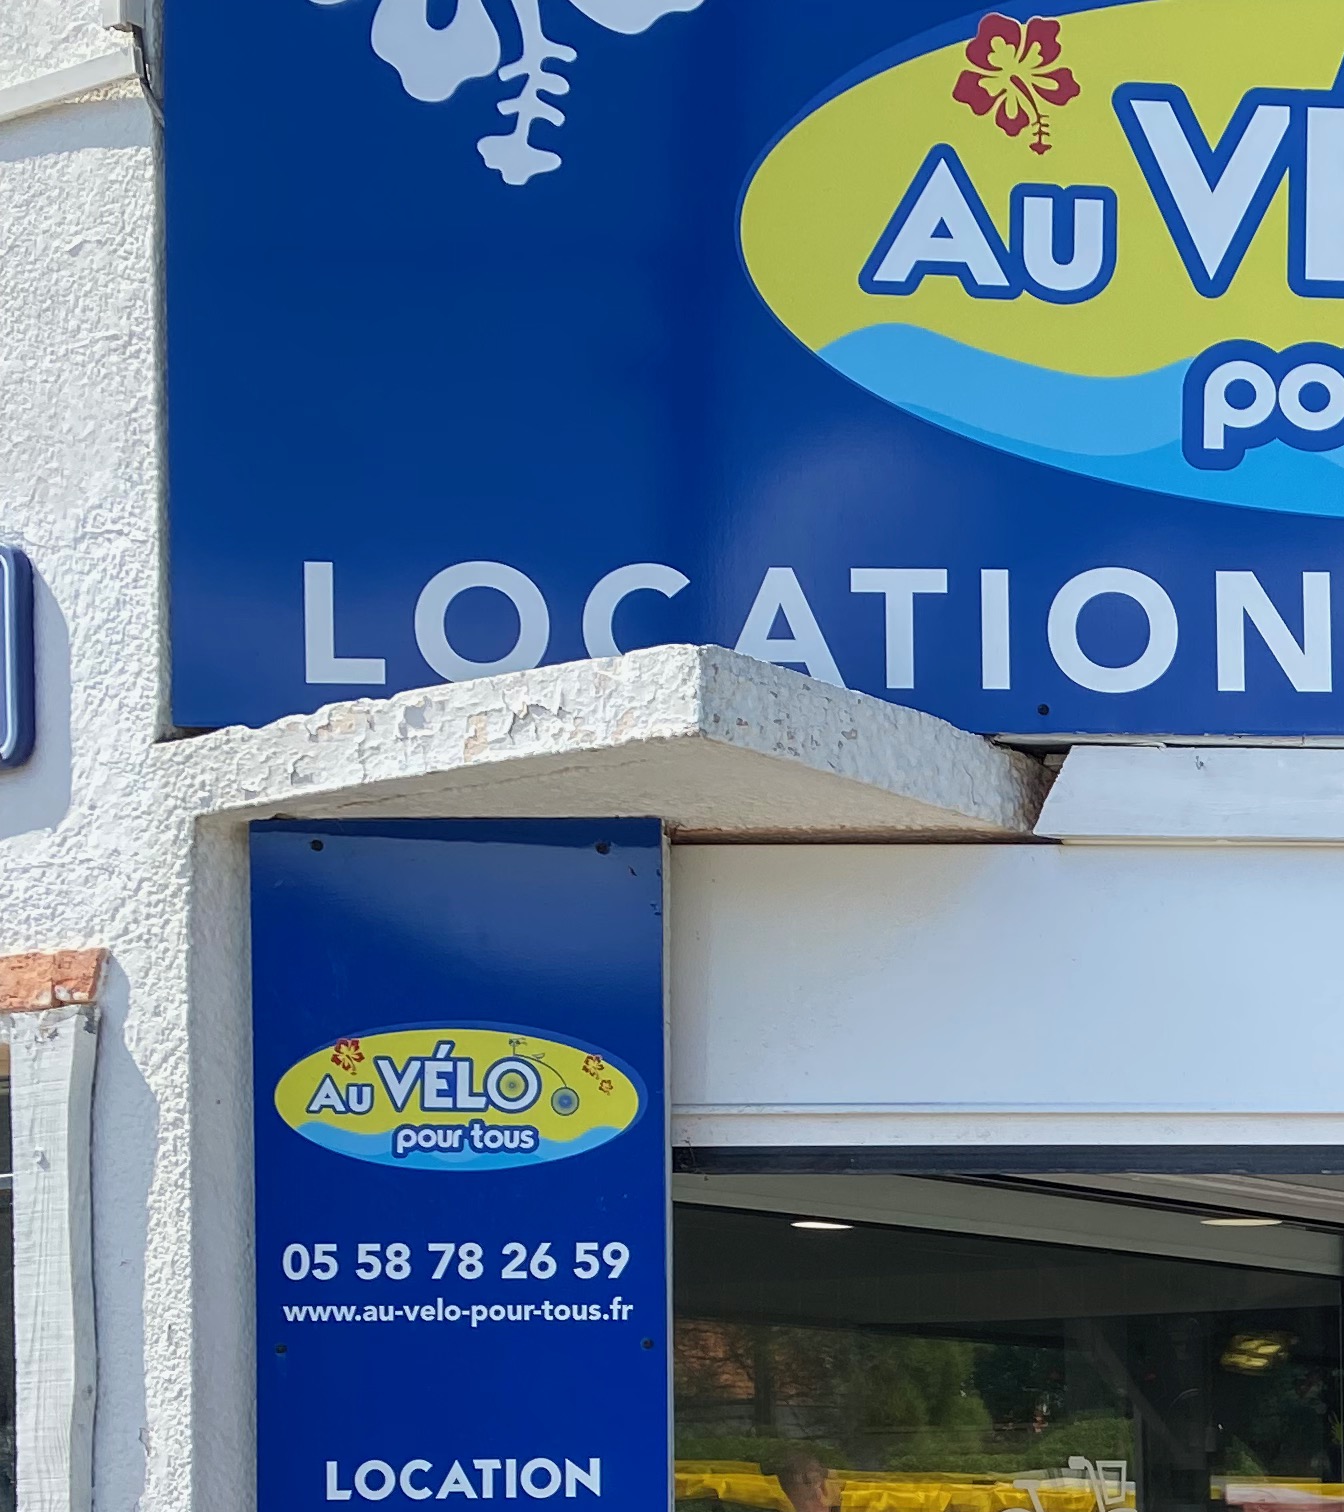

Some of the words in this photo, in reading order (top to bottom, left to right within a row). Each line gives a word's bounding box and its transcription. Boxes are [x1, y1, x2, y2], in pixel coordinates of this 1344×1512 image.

[302, 560, 1333, 694] LOCATION
[376, 1041, 541, 1113] VÉLO
[395, 1124, 465, 1157] pour
[469, 1121, 540, 1154] tous
[283, 1243, 338, 1280] 05
[357, 1243, 411, 1280] 58
[429, 1243, 484, 1280] 78
[501, 1243, 557, 1280] 26
[574, 1243, 630, 1280] 59
[283, 1297, 634, 1328] www.au-velo-pour-tous.fr
[326, 1457, 601, 1501] LOCATION
